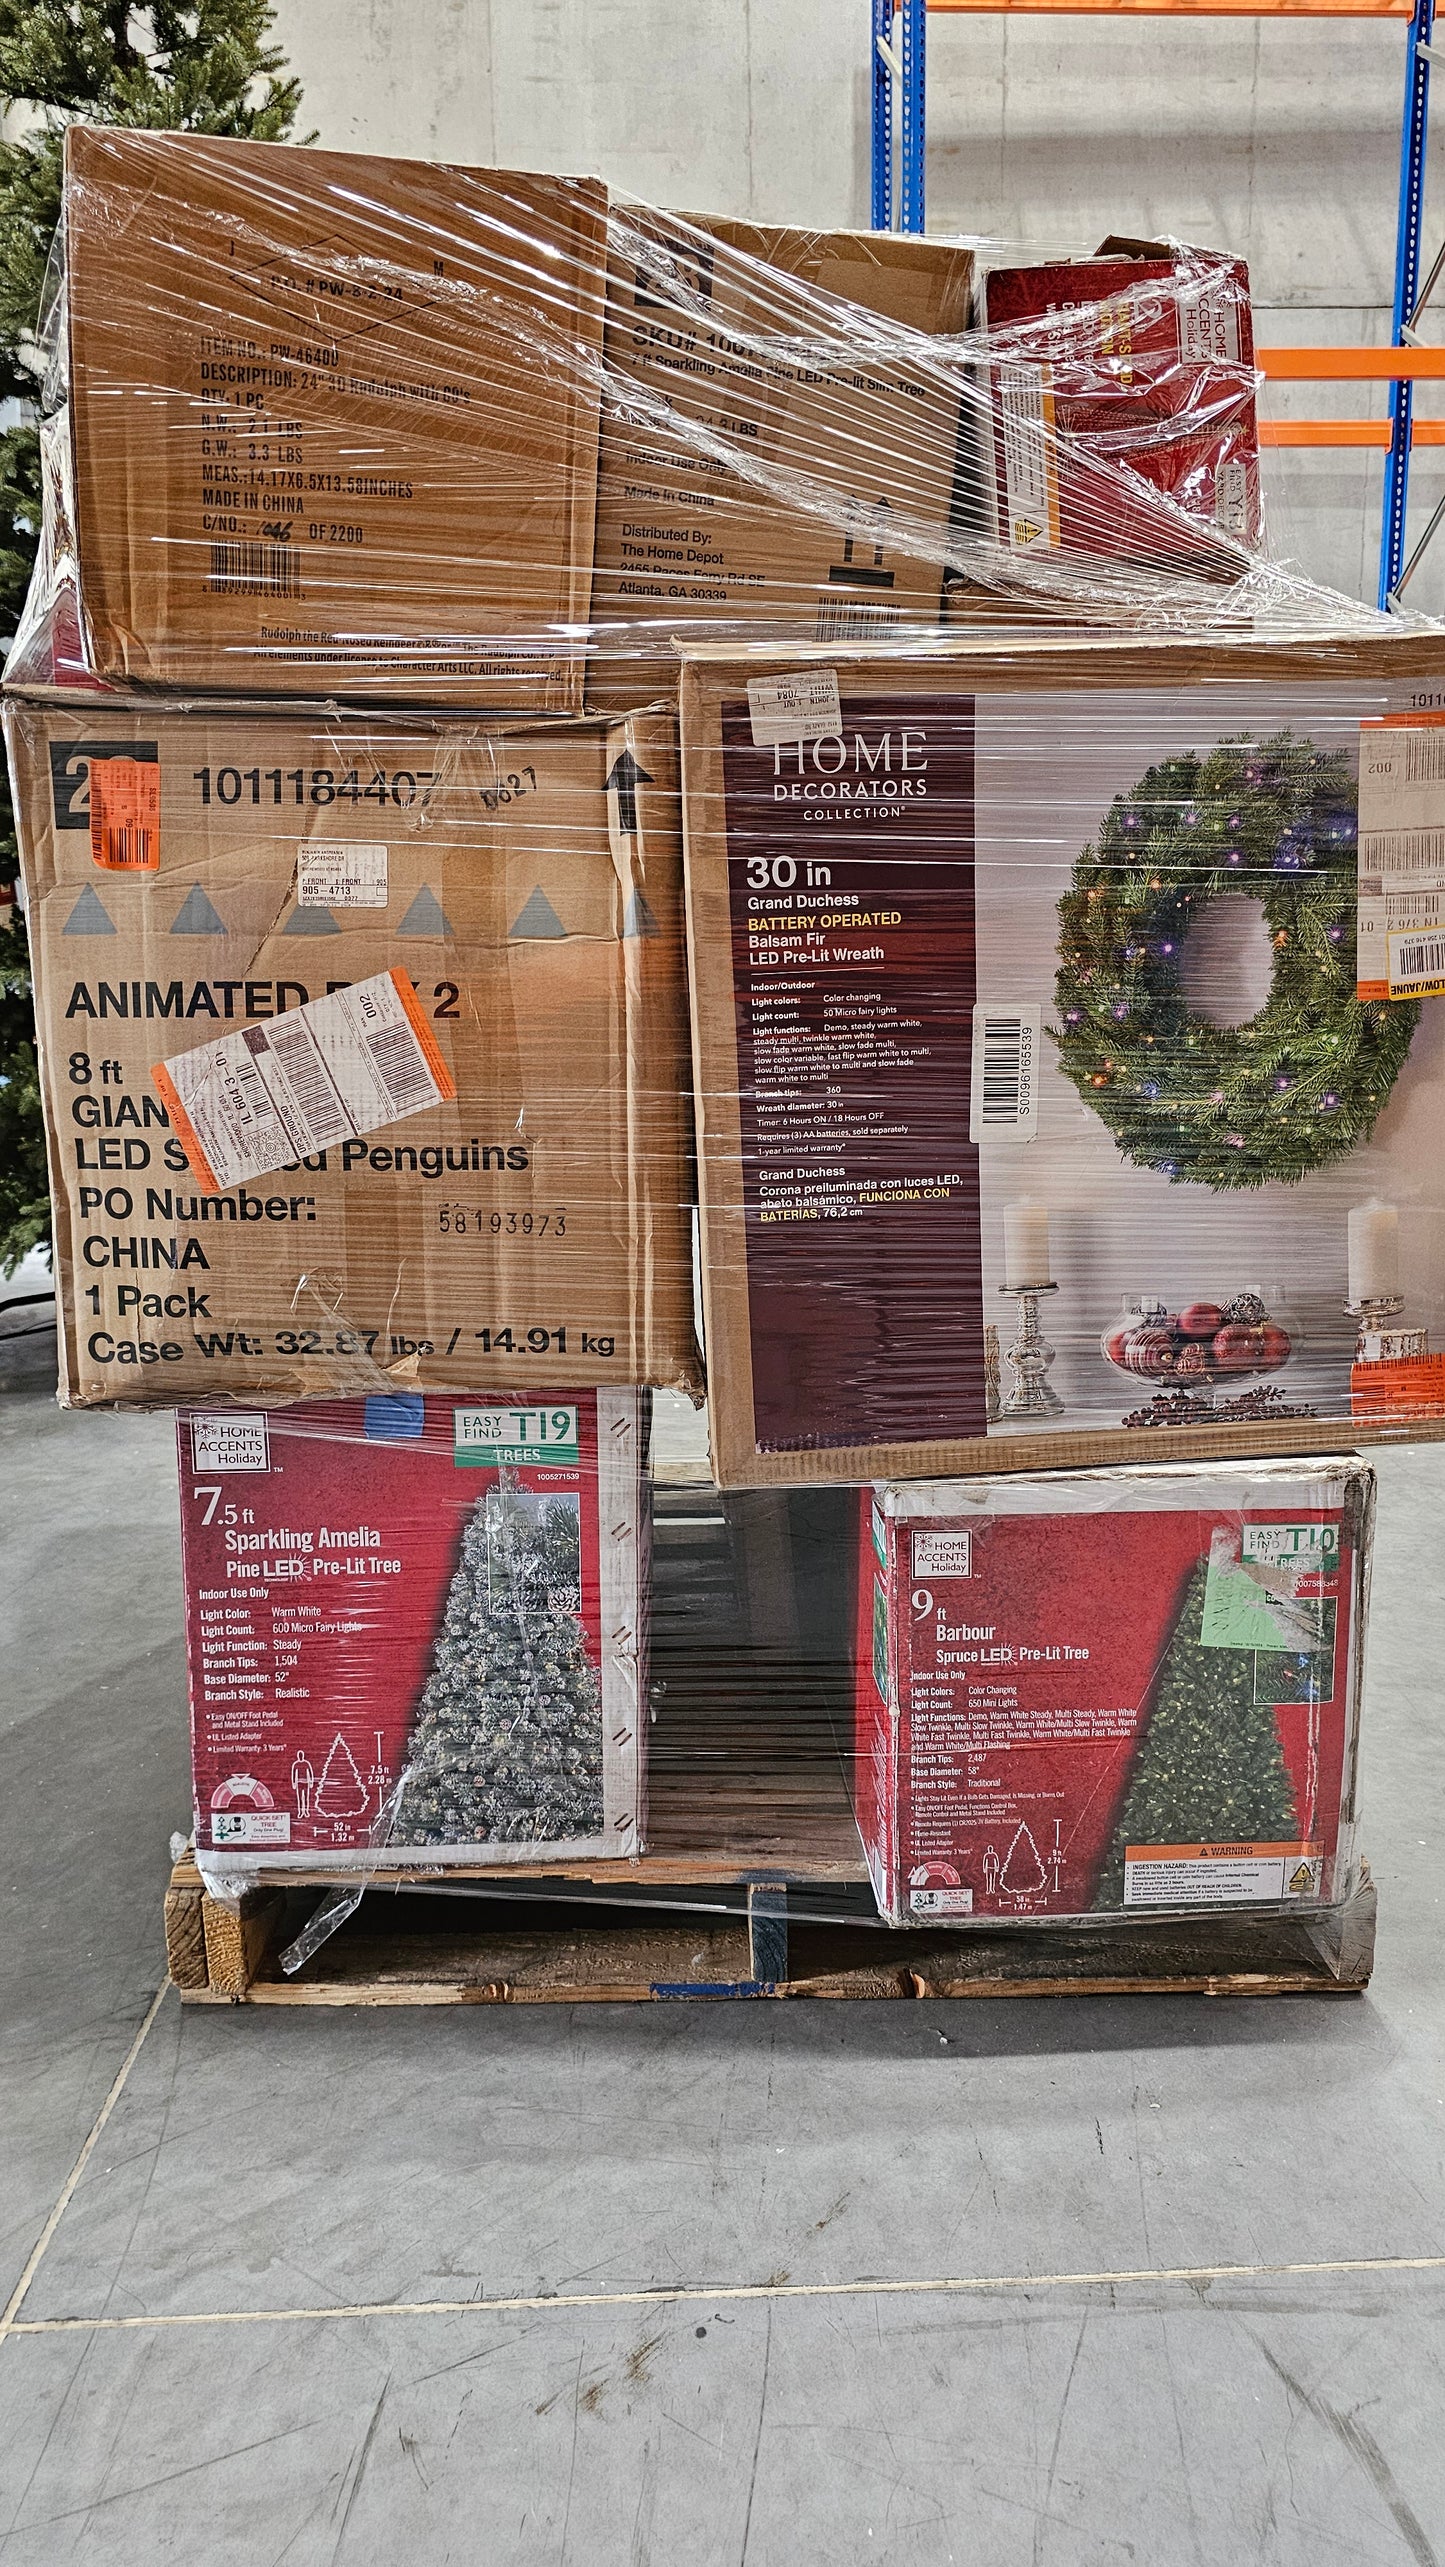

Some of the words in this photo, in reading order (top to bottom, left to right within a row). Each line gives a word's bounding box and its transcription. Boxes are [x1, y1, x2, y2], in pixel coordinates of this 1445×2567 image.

[632, 325, 696, 351] SKU#
[1214, 312, 1226, 358] HOME
[655, 355, 715, 375] Sparkling
[201, 362, 297, 387] DESCRIPTION:
[278, 447, 303, 464] LBS
[203, 489, 240, 507] MADE
[244, 493, 258, 509] IN
[263, 494, 304, 513] CHINA
[330, 526, 363, 542] 2200
[622, 524, 688, 542] Distributed
[692, 533, 712, 545] By:
[621, 544, 644, 556] The
[648, 547, 684, 560] Home
[687, 550, 724, 565] Depot
[668, 586, 687, 597] GA
[261, 627, 301, 642] Rudolph
[774, 732, 928, 775] HOME
[774, 779, 927, 801] DECORATORS
[747, 855, 797, 889] 30
[807, 862, 831, 886] in
[748, 896, 792, 910] Grand
[797, 894, 859, 908] Duchess
[748, 915, 817, 931] BATTERY
[820, 912, 901, 927] OPERATED
[749, 935, 802, 948] Balsam
[807, 933, 826, 945] Fir
[750, 952, 779, 965] LED
[784, 950, 830, 964] Pre-Lit
[833, 947, 884, 961] Wreath
[751, 982, 815, 992] Indoor/Outdoor
[64, 981, 309, 1018] ANIMATED
[433, 982, 460, 1018] 2
[752, 999, 772, 1007] Light
[774, 997, 800, 1005] colors:
[823, 994, 844, 1002] Color
[846, 993, 881, 1002] changing
[753, 1013, 774, 1022] Light
[775, 1012, 799, 1020] count:
[835, 1008, 856, 1016] Micro
[876, 1007, 897, 1015] lights
[68, 1052, 92, 1085] 8
[99, 1059, 122, 1085] ft
[1020, 1027, 1032, 1115] S0096165539
[790, 1116, 812, 1125] Hours
[813, 1115, 827, 1123] ON
[844, 1113, 867, 1122] Hours
[868, 1112, 884, 1120] OFF
[75, 1140, 151, 1170] LED
[343, 1138, 529, 1178] Penguins
[759, 1169, 794, 1181] Grand
[797, 1167, 845, 1178] Duchess
[760, 1185, 800, 1197] Corona
[804, 1180, 877, 1196] preiluminada
[880, 1179, 901, 1189] con
[904, 1177, 934, 1187] luces
[937, 1174, 963, 1186] LED,
[796, 1195, 857, 1208] balsámico,
[859, 1190, 921, 1203] FUNCIONA
[923, 1188, 950, 1199] CON
[80, 1188, 132, 1218] PO
[147, 1188, 316, 1222] Number:
[438, 1210, 567, 1237] 58193973
[823, 1207, 848, 1218] 76,2
[850, 1209, 863, 1217] cm
[82, 1237, 210, 1270] CHINA
[85, 1286, 100, 1316] 1
[119, 1285, 212, 1318] Pack
[87, 1332, 184, 1366] Case
[193, 1332, 263, 1358] Wt:
[274, 1330, 379, 1357] 32.87
[390, 1335, 435, 1357] lbs
[474, 1328, 567, 1354] 14.91
[581, 1333, 615, 1358] kg
[463, 1416, 501, 1427] EASY
[220, 1427, 263, 1438] HOME
[465, 1428, 501, 1438] FIND
[199, 1441, 263, 1452] ACCENTS
[218, 1454, 263, 1466] Holiday
[493, 1449, 540, 1461] TREES
[194, 1487, 238, 1526] 7.5
[242, 1509, 255, 1524] ft
[225, 1529, 314, 1555] Sparkling
[319, 1527, 381, 1548] Amelia
[1250, 1530, 1280, 1540] EASY
[935, 1542, 967, 1550] HOME
[1250, 1541, 1280, 1549] FIND
[917, 1553, 967, 1562] ACCENTS
[227, 1561, 260, 1578] Pine
[263, 1560, 304, 1577] LED
[313, 1558, 365, 1576] Pre-Lit
[368, 1557, 401, 1574] Tree
[932, 1563, 966, 1573] Holiday
[199, 1589, 227, 1600] Indoor
[231, 1588, 247, 1598] Use
[250, 1587, 269, 1599] Only
[912, 1590, 933, 1621] 9
[937, 1608, 947, 1621] ft
[200, 1610, 223, 1621] Light
[225, 1609, 251, 1619] Color:
[272, 1607, 296, 1617] Warm
[298, 1606, 321, 1616] White
[201, 1626, 224, 1638] Light
[226, 1625, 255, 1635] Count:
[273, 1623, 289, 1633] 600
[937, 1624, 996, 1641] Barbour
[202, 1642, 225, 1654] Light
[227, 1641, 267, 1652] Function:
[273, 1639, 301, 1651] Steady
[203, 1658, 235, 1669] Branch
[237, 1657, 258, 1668] Tips:
[275, 1655, 297, 1667] 1,504
[936, 1649, 978, 1665] Spruce
[981, 1648, 1012, 1661] LED
[1020, 1647, 1061, 1660] Pre-Lit
[1063, 1646, 1089, 1659] Tree
[204, 1675, 226, 1685] Base
[228, 1673, 271, 1684] Diameter:
[911, 1671, 934, 1682] Indoor
[935, 1671, 949, 1679] Use
[951, 1671, 965, 1680] Only
[205, 1690, 236, 1701] Branch
[239, 1690, 264, 1701] Style:
[275, 1688, 310, 1698] Realistic
[911, 1688, 929, 1697] Light
[931, 1687, 955, 1696] Colors:
[969, 1687, 985, 1695] Color
[986, 1686, 1017, 1695] Changing
[911, 1701, 929, 1710] Light
[931, 1700, 953, 1709] Count:
[911, 1755, 937, 1764] Branch
[911, 1768, 928, 1777] Base
[930, 1768, 962, 1776] Diameter:
[911, 1780, 936, 1789] Branch
[938, 1780, 957, 1789] Style:
[968, 1779, 1001, 1787] Traditional
[1211, 1847, 1253, 1856] WARNING
